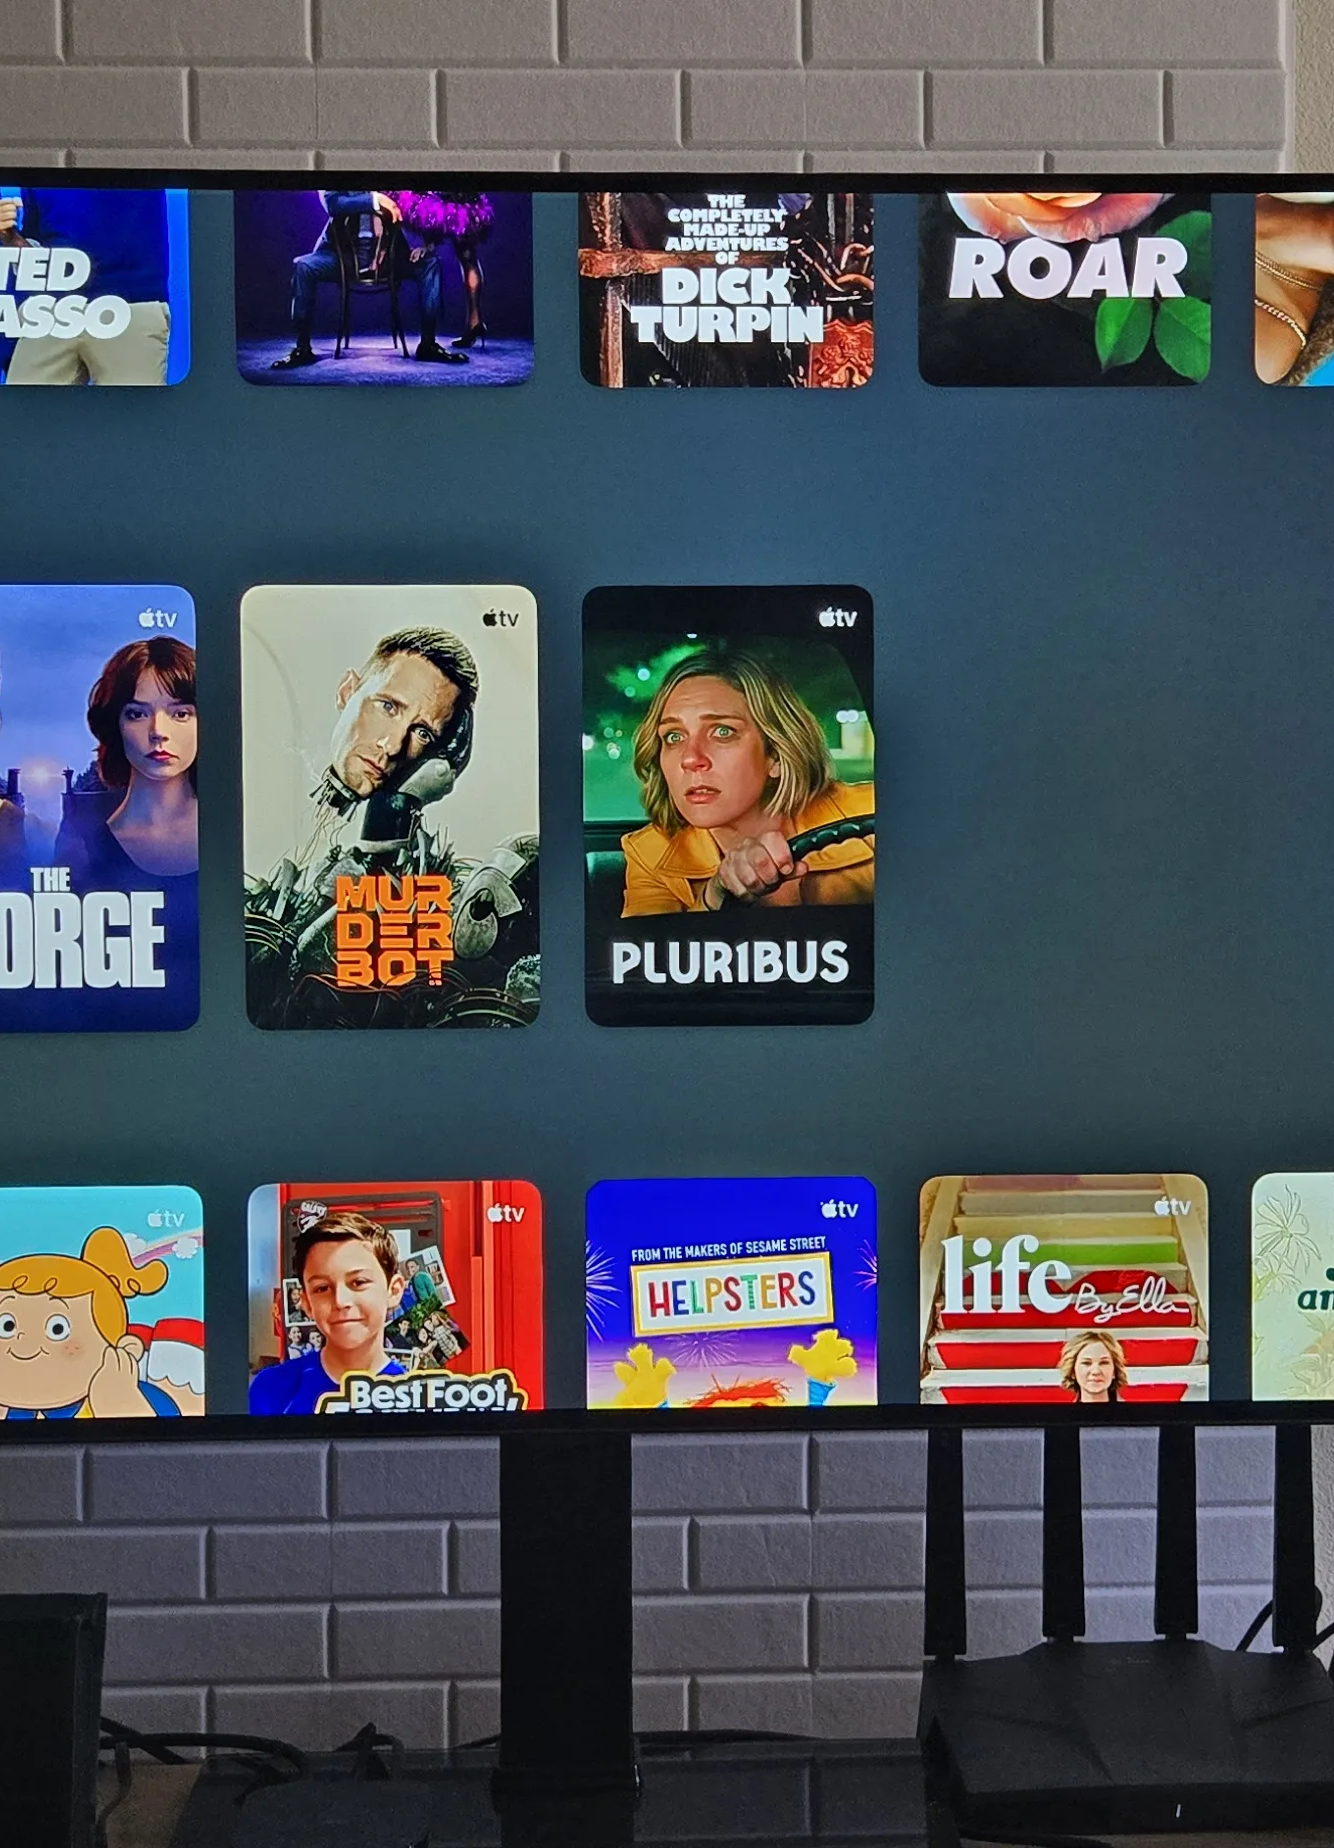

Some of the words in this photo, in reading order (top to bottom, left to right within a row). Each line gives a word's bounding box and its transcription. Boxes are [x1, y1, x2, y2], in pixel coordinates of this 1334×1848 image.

[707, 194, 746, 208] THE
[667, 208, 787, 222] COMPLETELY
[683, 223, 771, 236] MADE-UP
[665, 237, 789, 251] ADVENTURES
[715, 252, 740, 265] OF
[948, 236, 1188, 299] ROAR
[662, 267, 791, 304] DICK
[630, 306, 824, 343] TURPIN
[156, 609, 178, 628] tv
[499, 609, 519, 628] tv
[837, 608, 858, 628] tv
[30, 867, 70, 892] THE
[336, 875, 454, 911] MUR
[336, 914, 454, 949] DER
[336, 951, 455, 987] BOT
[502, 1204, 525, 1223] tv
[837, 1200, 859, 1218] tv
[1170, 1197, 1192, 1216] tv
[163, 1210, 185, 1228] tv
[631, 1249, 661, 1262] FROM
[663, 1247, 682, 1260] THE
[685, 1243, 727, 1257] MAKERS
[729, 1242, 743, 1255] OF
[745, 1239, 788, 1253] SESAME
[789, 1235, 826, 1250] STREET
[940, 1234, 1074, 1314] life
[648, 1270, 816, 1318] HELPSTERS
[1074, 1282, 1117, 1323] By
[1117, 1276, 1190, 1313] Ella
[352, 1380, 422, 1409] Best
[428, 1378, 508, 1408] Foot
